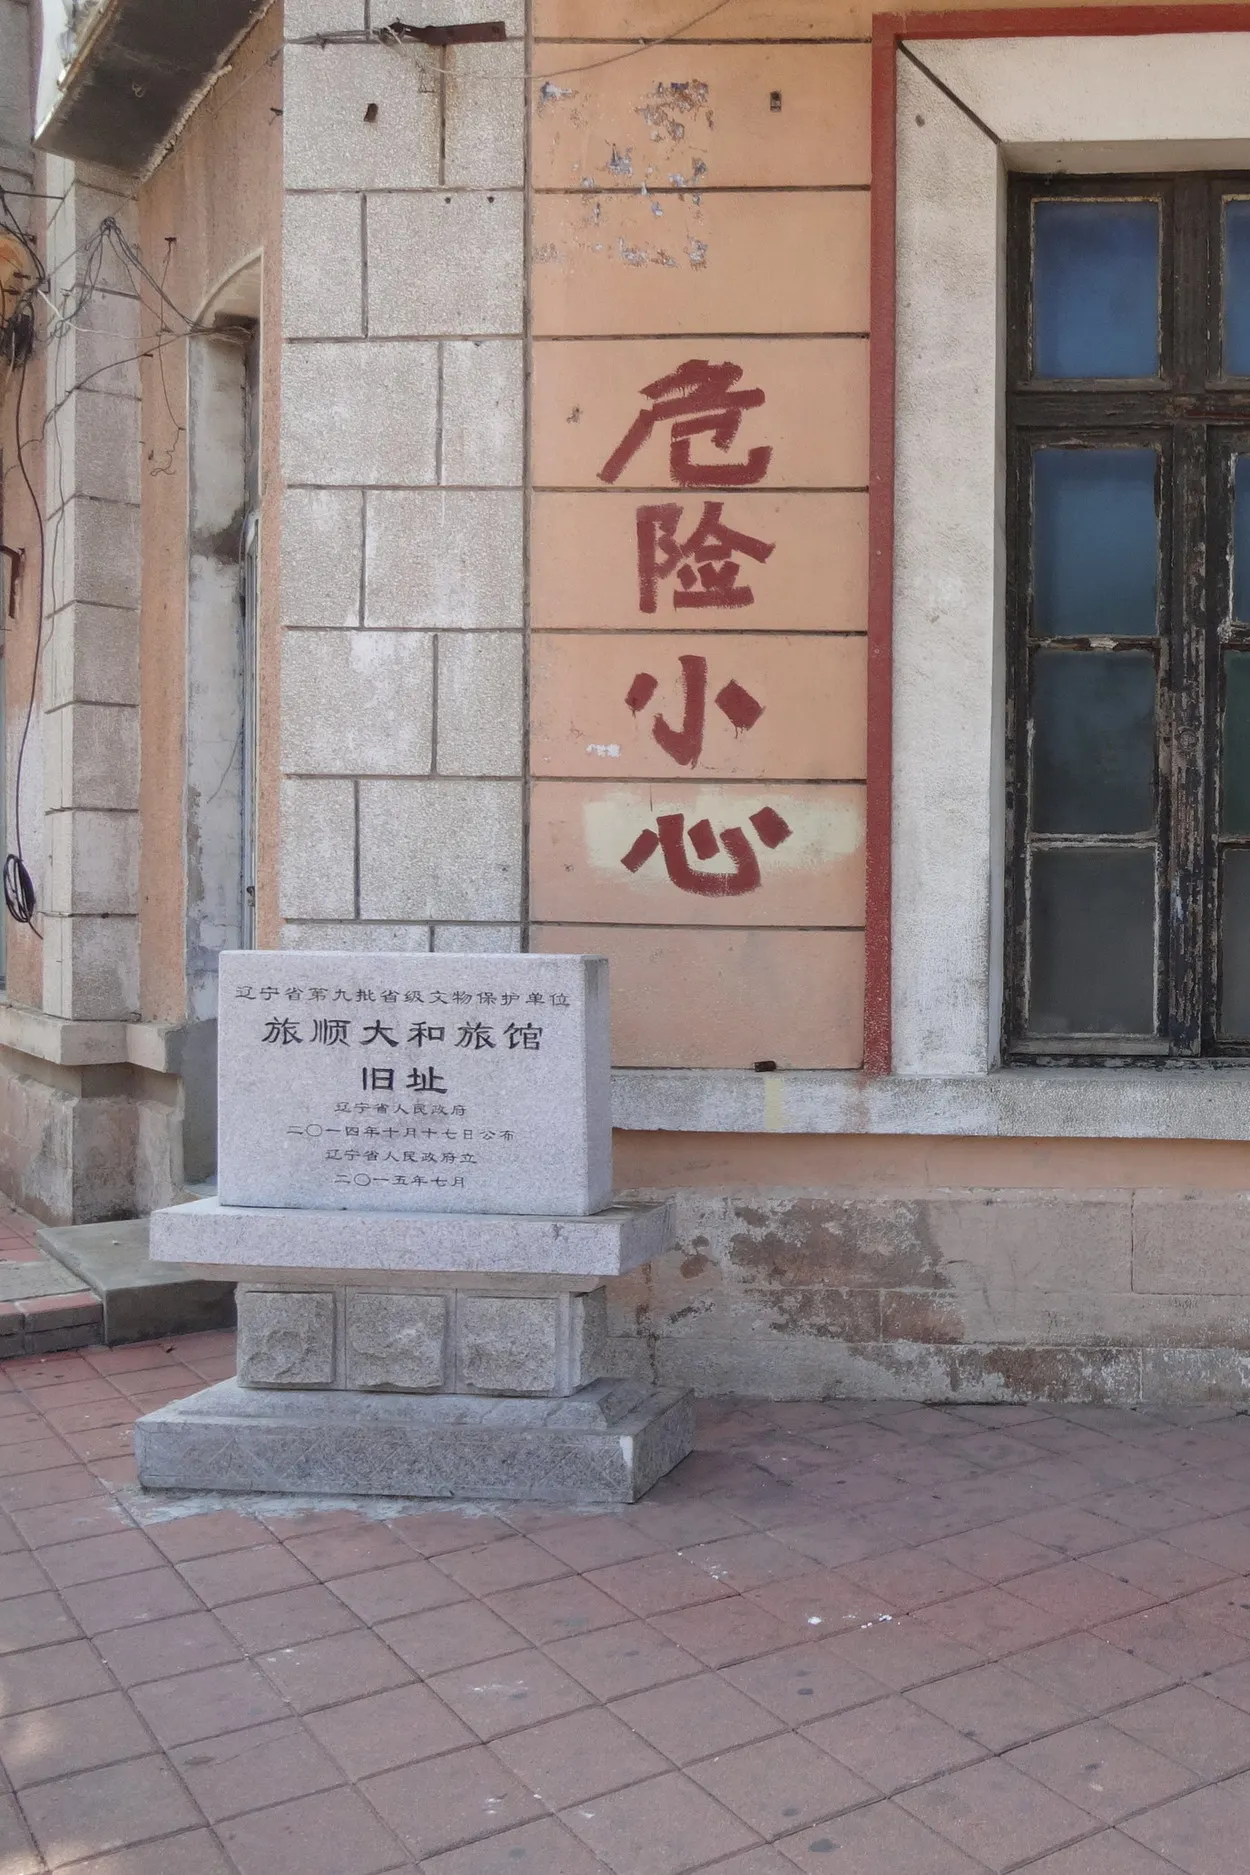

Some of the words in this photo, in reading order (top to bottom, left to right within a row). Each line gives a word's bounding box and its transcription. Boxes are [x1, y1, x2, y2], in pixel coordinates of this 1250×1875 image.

[597, 359, 793, 897] 危险小心
[235, 985, 571, 1008] 辽宁省第九批省级文物保护单位
[261, 1016, 543, 1051] 旅顺大和旅馆
[362, 1066, 448, 1094] 旧址
[334, 1101, 467, 1117] 辽宁省人民政府
[325, 1148, 478, 1165] 辽宁省人民政府立
